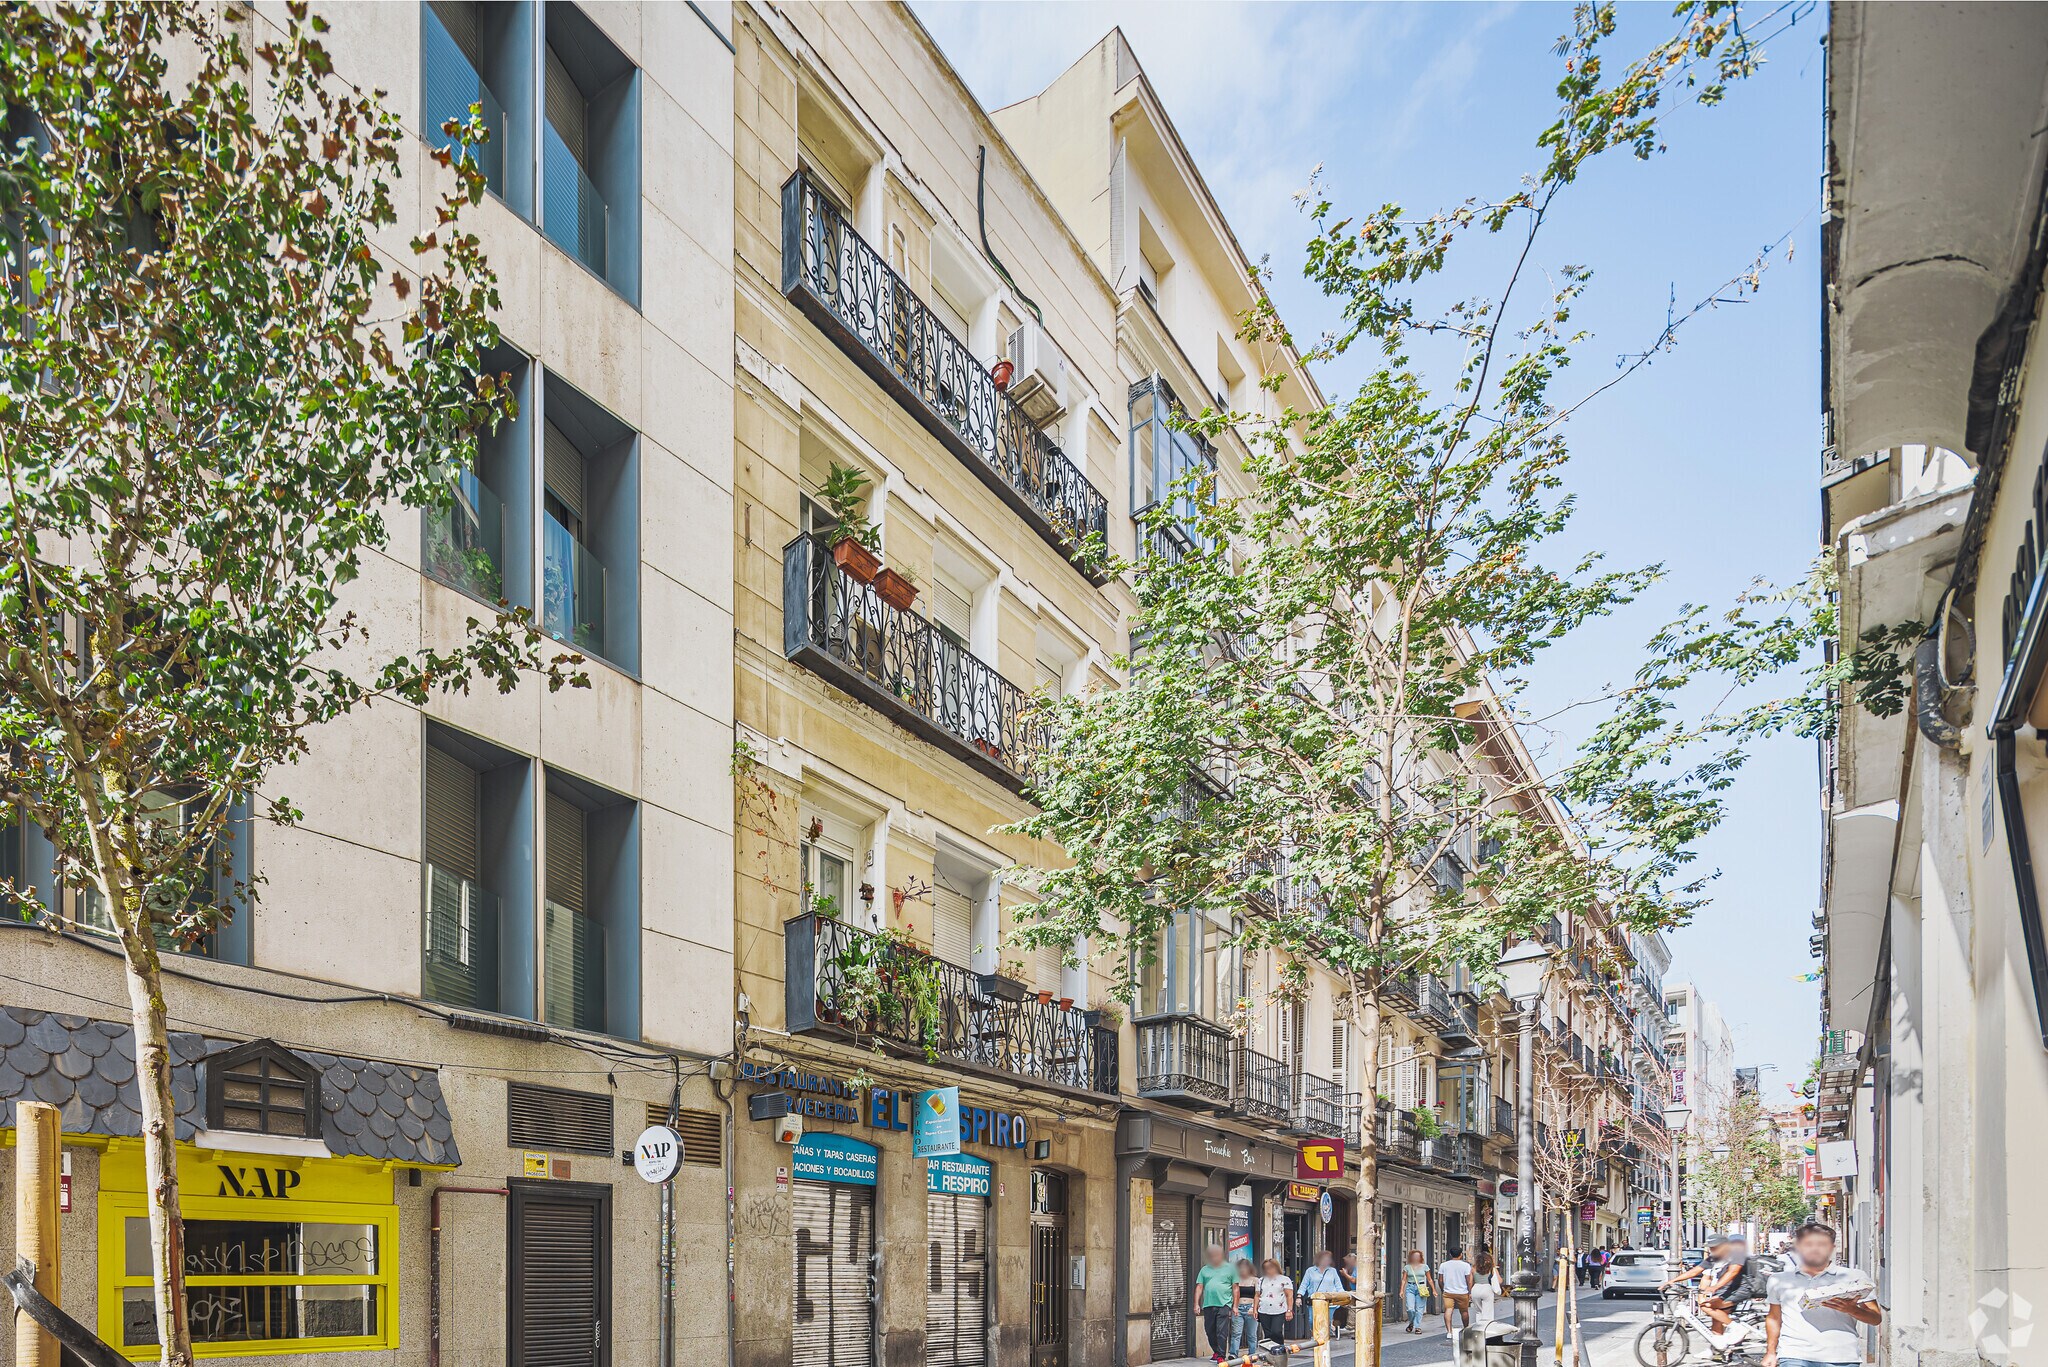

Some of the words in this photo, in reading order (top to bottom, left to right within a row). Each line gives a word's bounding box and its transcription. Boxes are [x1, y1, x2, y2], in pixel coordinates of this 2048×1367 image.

[871, 1087, 908, 1132] EL
[959, 1103, 1027, 1150] SPIRO
[640, 1142, 671, 1160] NAP
[815, 1148, 822, 1158] Y
[823, 1149, 844, 1161] TAPAS
[845, 1152, 877, 1164] CASERAS
[916, 1142, 956, 1153] RESTAURANTE
[792, 1162, 825, 1175] ACIONES
[826, 1166, 832, 1175] Y
[833, 1167, 875, 1180] BOCADILLOS
[941, 1161, 990, 1176] RESTAURANTE
[216, 1164, 301, 1199] NAP
[942, 1175, 989, 1195] RESPIRO
